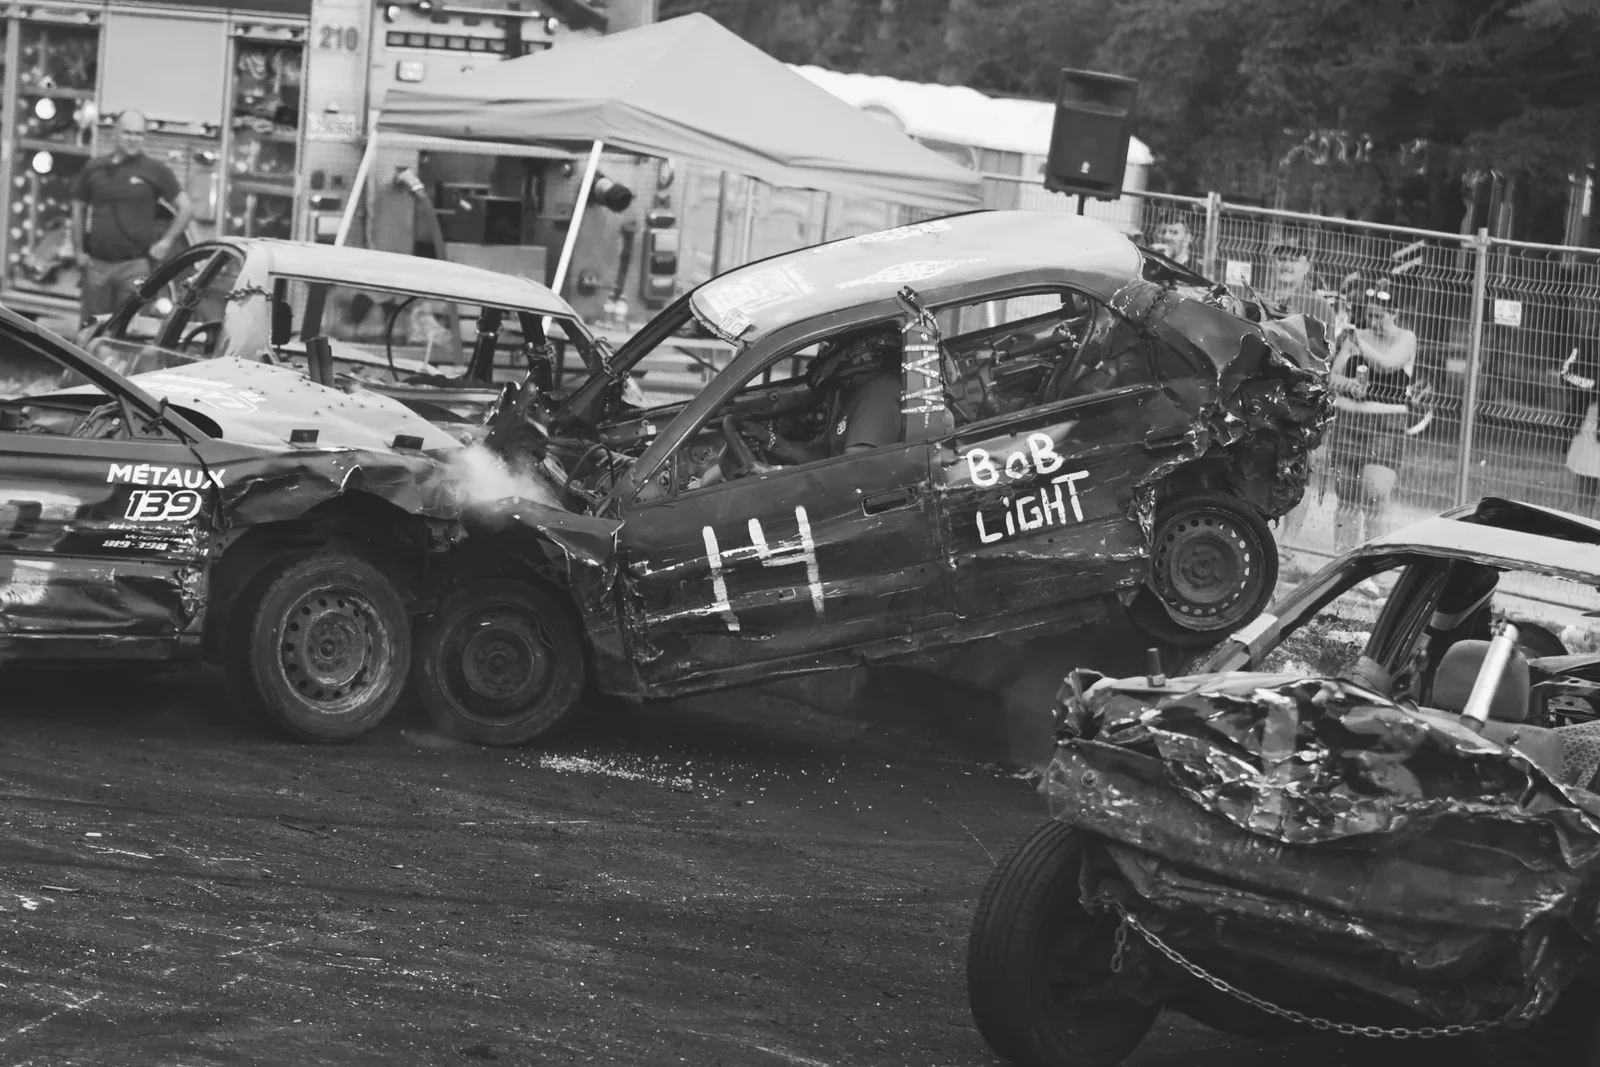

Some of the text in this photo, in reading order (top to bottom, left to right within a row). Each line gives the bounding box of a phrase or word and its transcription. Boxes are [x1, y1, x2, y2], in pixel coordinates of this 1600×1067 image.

[320, 25, 358, 52] 210
[106, 464, 225, 489] MÉTAUX
[125, 490, 202, 521] 139
